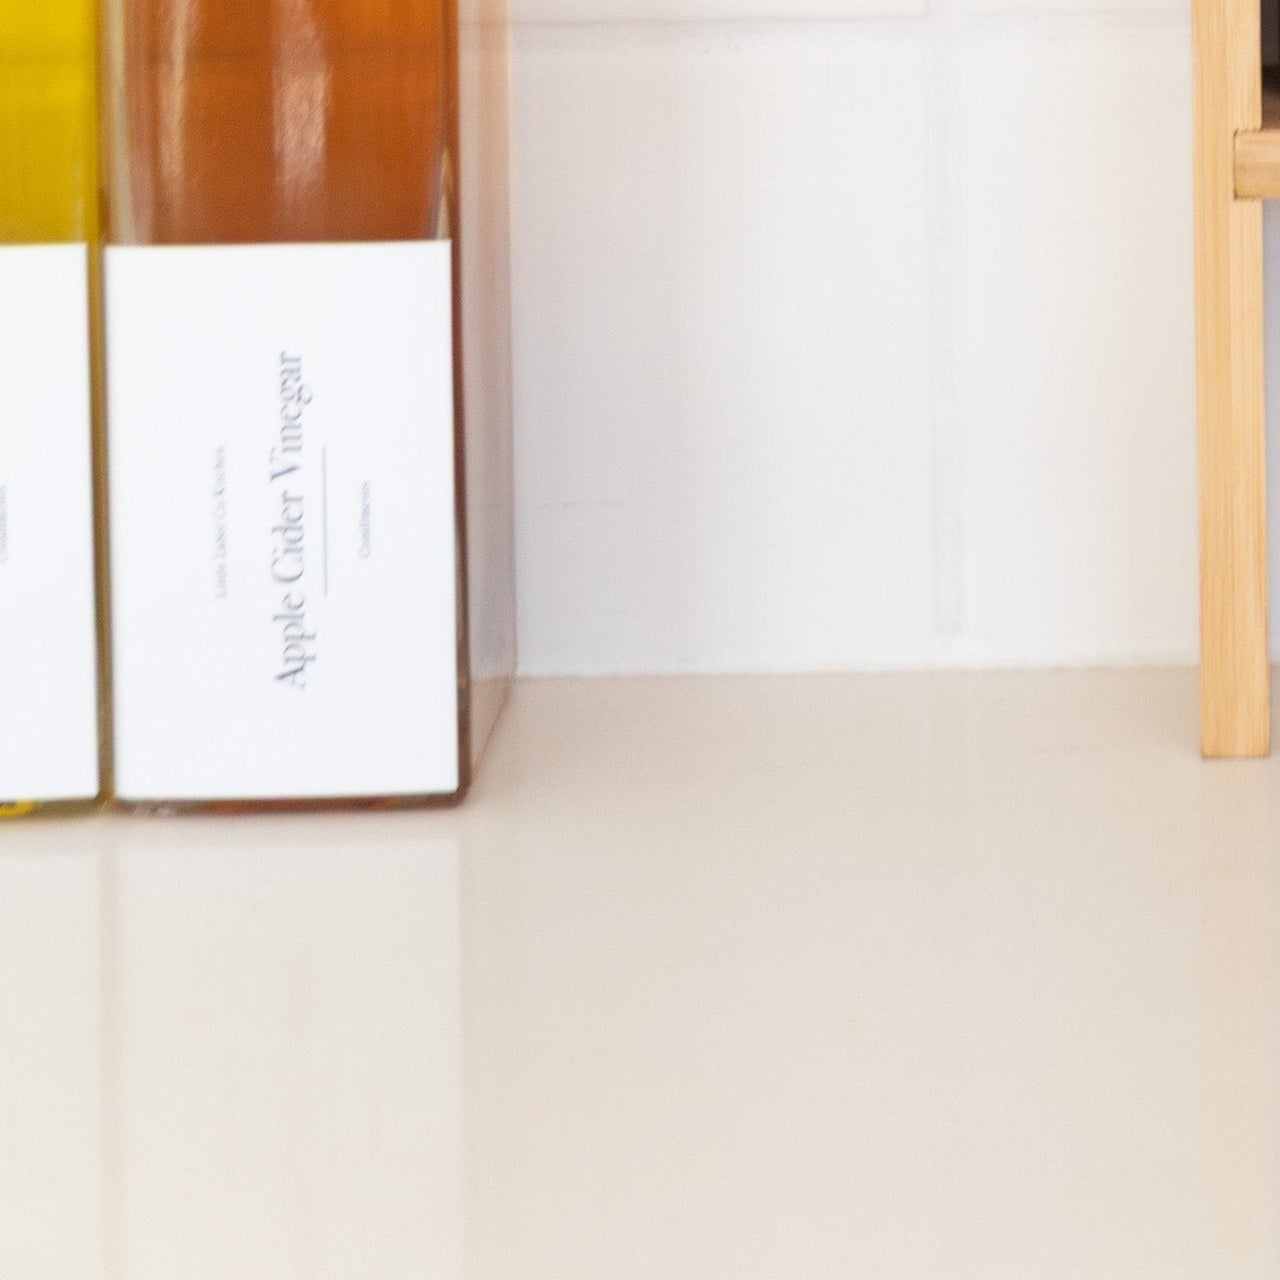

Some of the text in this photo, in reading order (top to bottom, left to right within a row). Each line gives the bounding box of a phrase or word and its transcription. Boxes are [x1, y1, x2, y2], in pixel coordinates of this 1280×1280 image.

[269, 350, 317, 690] Apple Cider Vinegar
